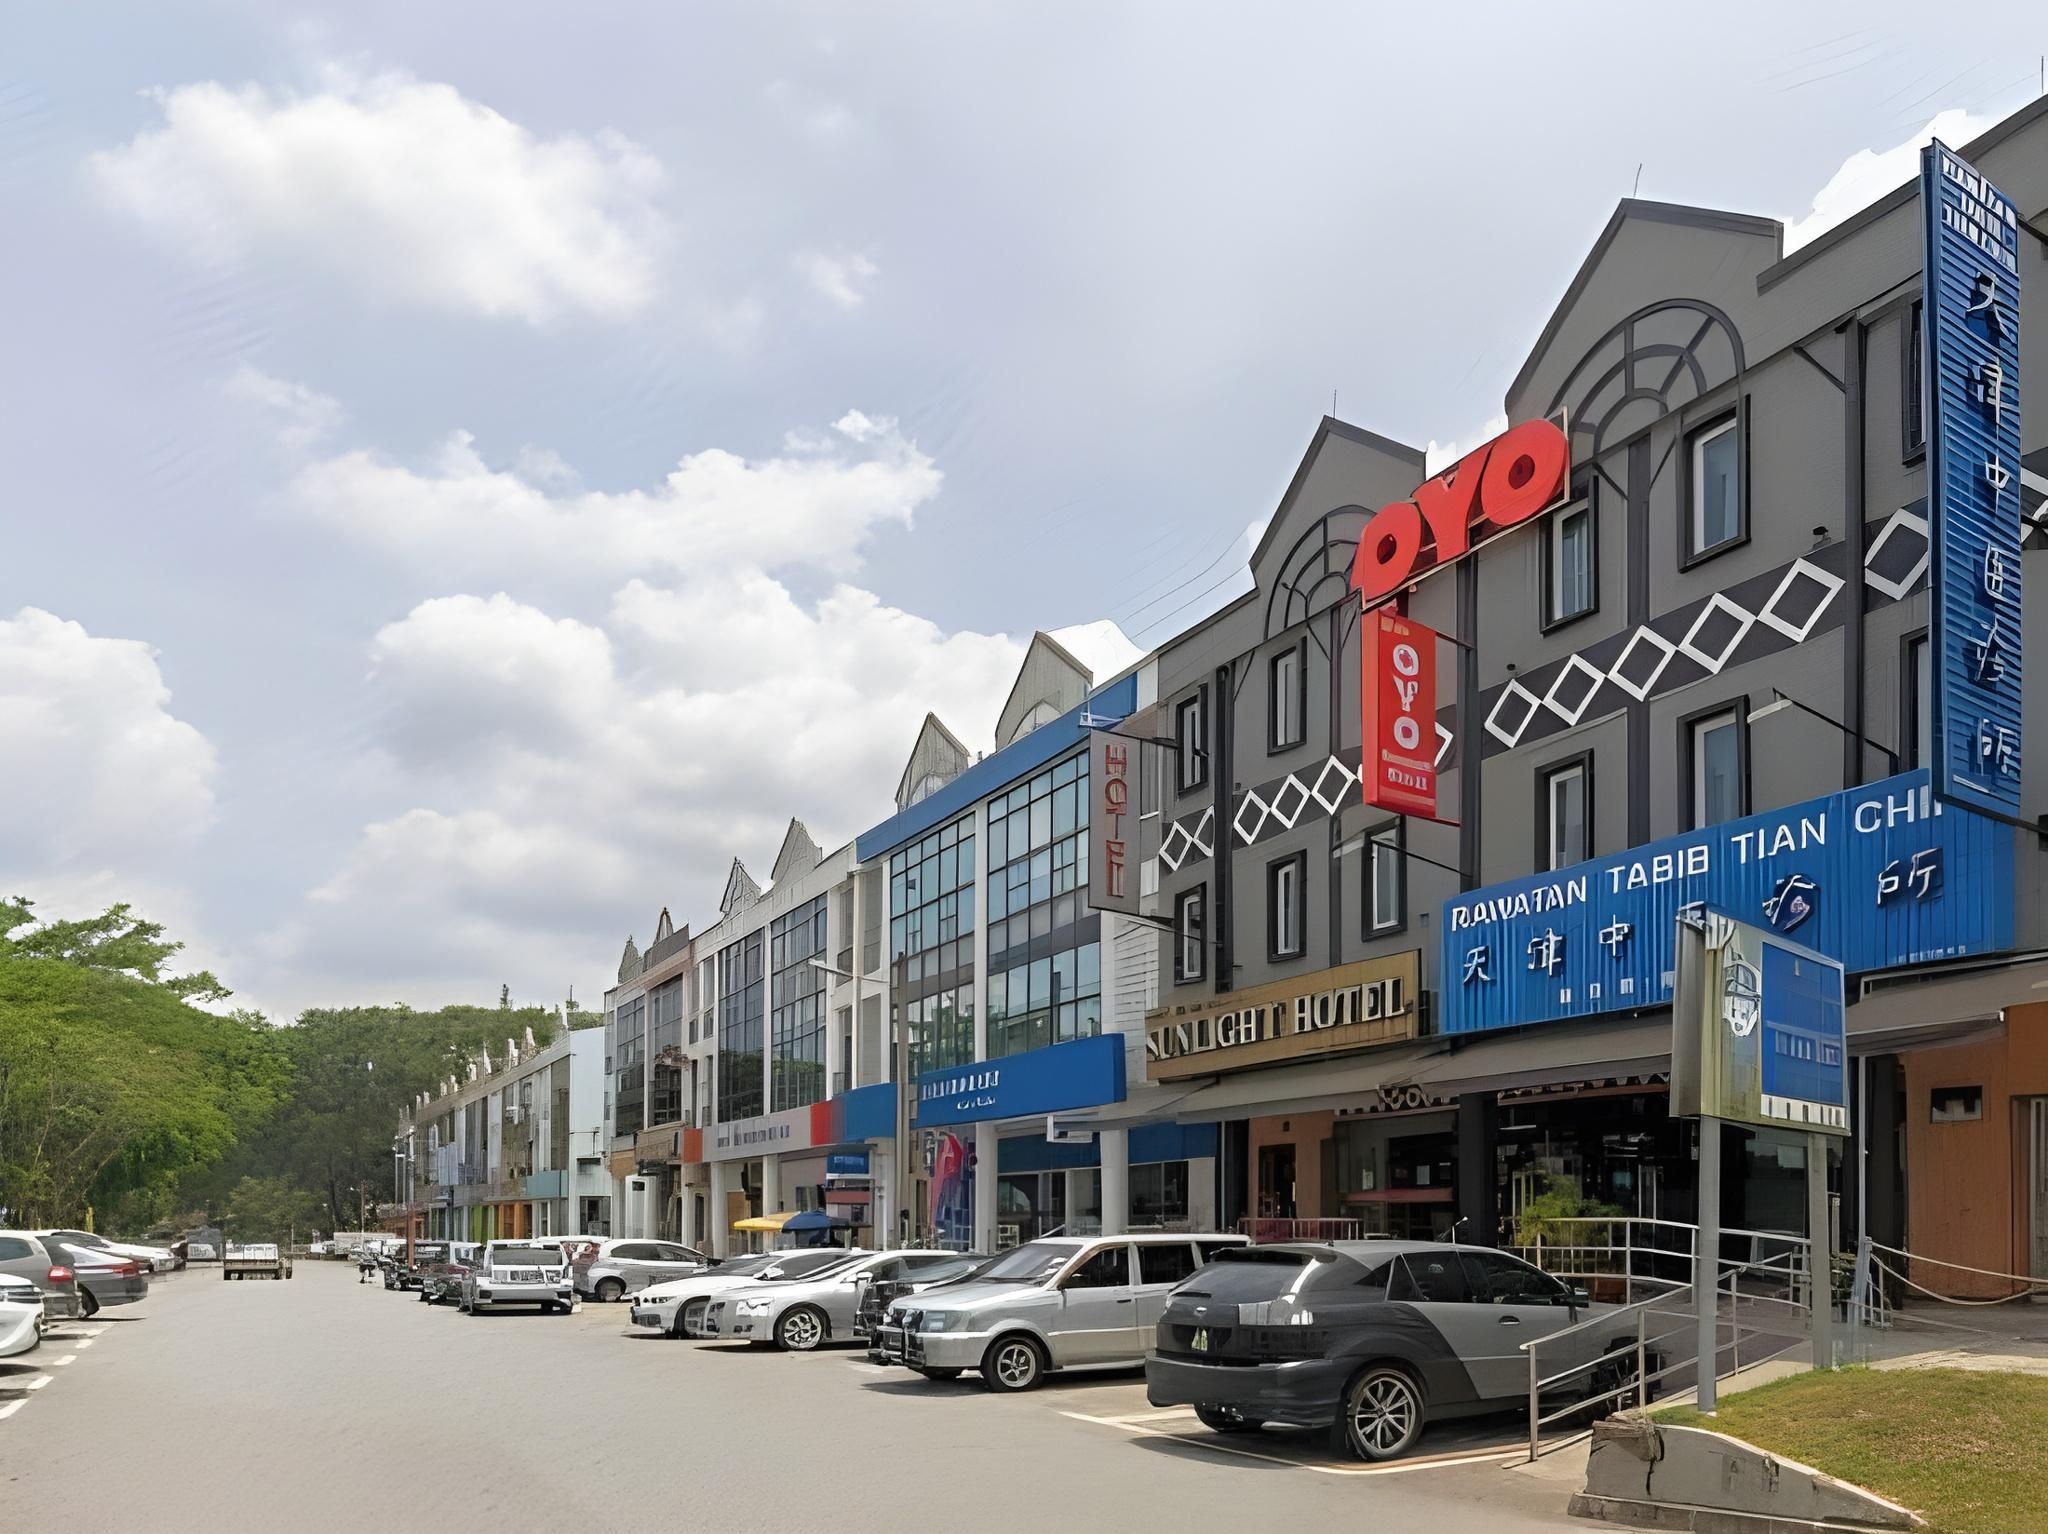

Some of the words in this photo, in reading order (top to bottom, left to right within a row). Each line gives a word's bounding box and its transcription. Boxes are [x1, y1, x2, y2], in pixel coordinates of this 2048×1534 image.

[1351, 418, 1570, 602] OYO
[1392, 643, 1420, 750] OYO
[1605, 845, 1709, 894] TABIB
[1731, 812, 1826, 865] TIAN
